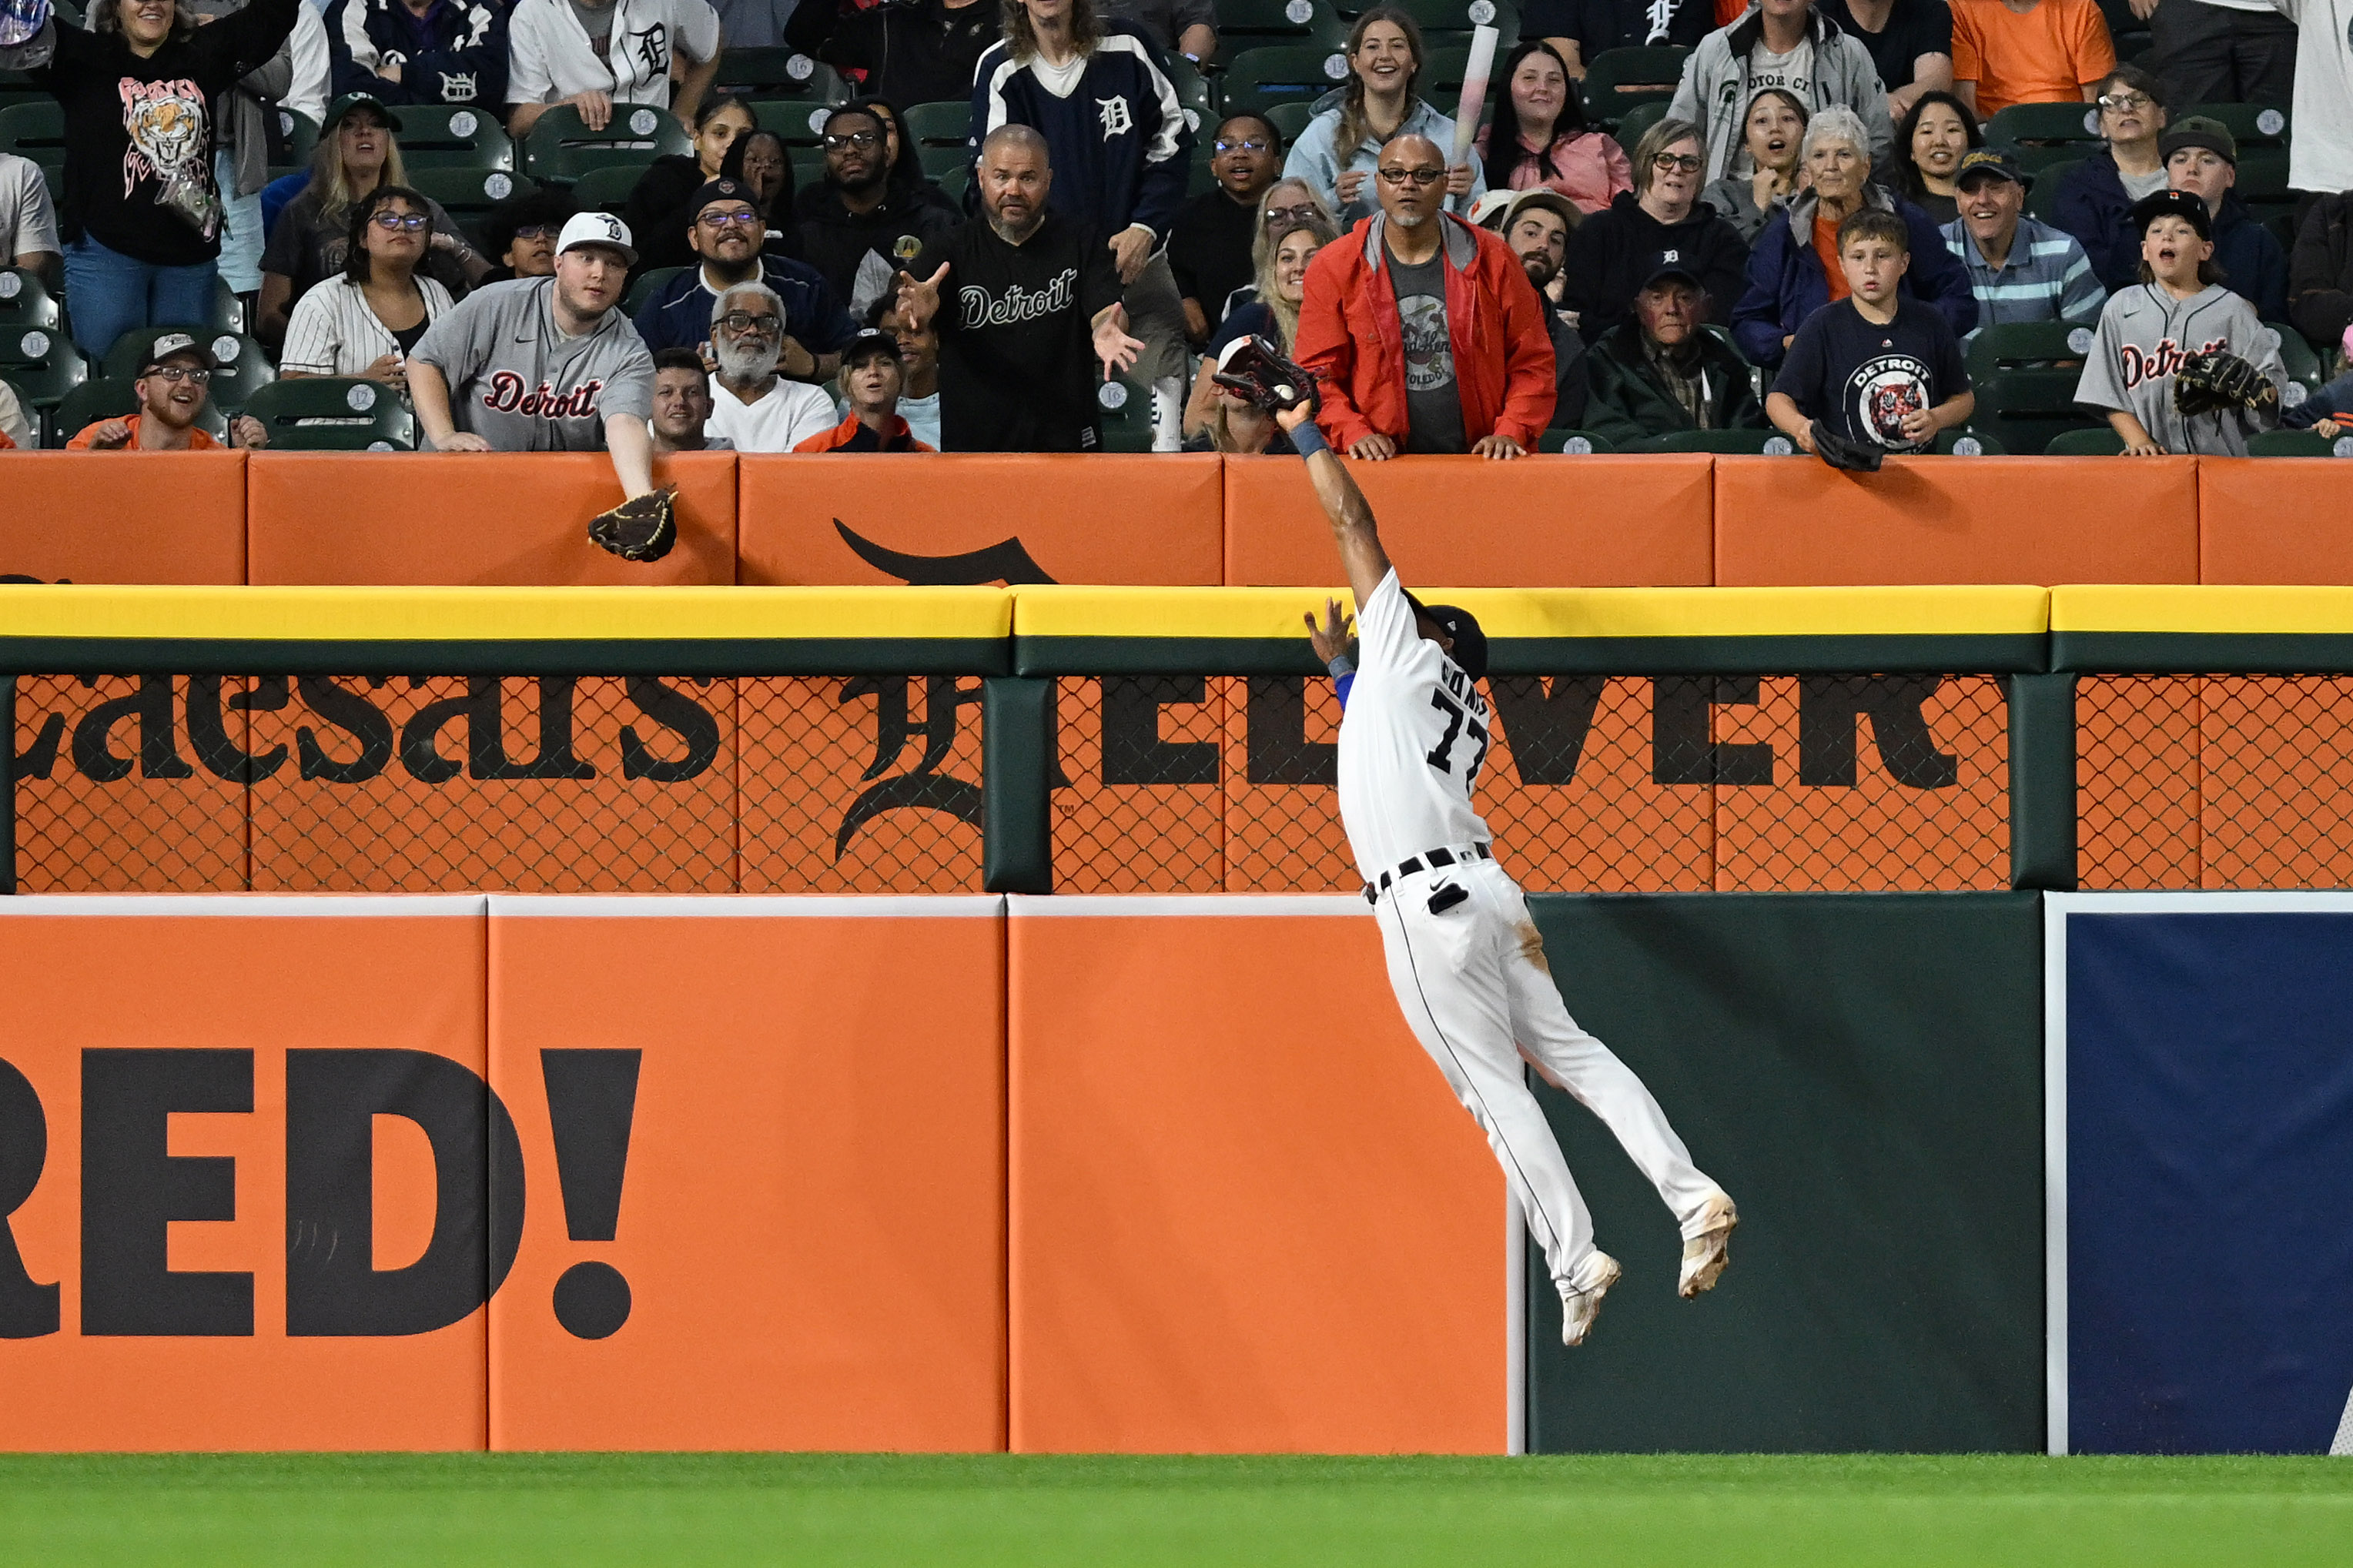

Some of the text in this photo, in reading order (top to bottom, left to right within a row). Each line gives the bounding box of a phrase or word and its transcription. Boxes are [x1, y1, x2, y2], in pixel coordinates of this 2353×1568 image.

[1747, 75, 1785, 91] OTOR
[1095, 94, 1133, 143] D
[1663, 249, 1679, 262] D
[957, 268, 1077, 330] Detroit
[1406, 371, 1442, 385] OLEDO
[1854, 359, 1930, 387] DETROIT
[483, 369, 604, 420] Detroit
[1108, 390, 1120, 401] 16
[1772, 443, 1784, 455] 18
[1427, 686, 1489, 798] 77
[0, 1047, 643, 1342] ED!
